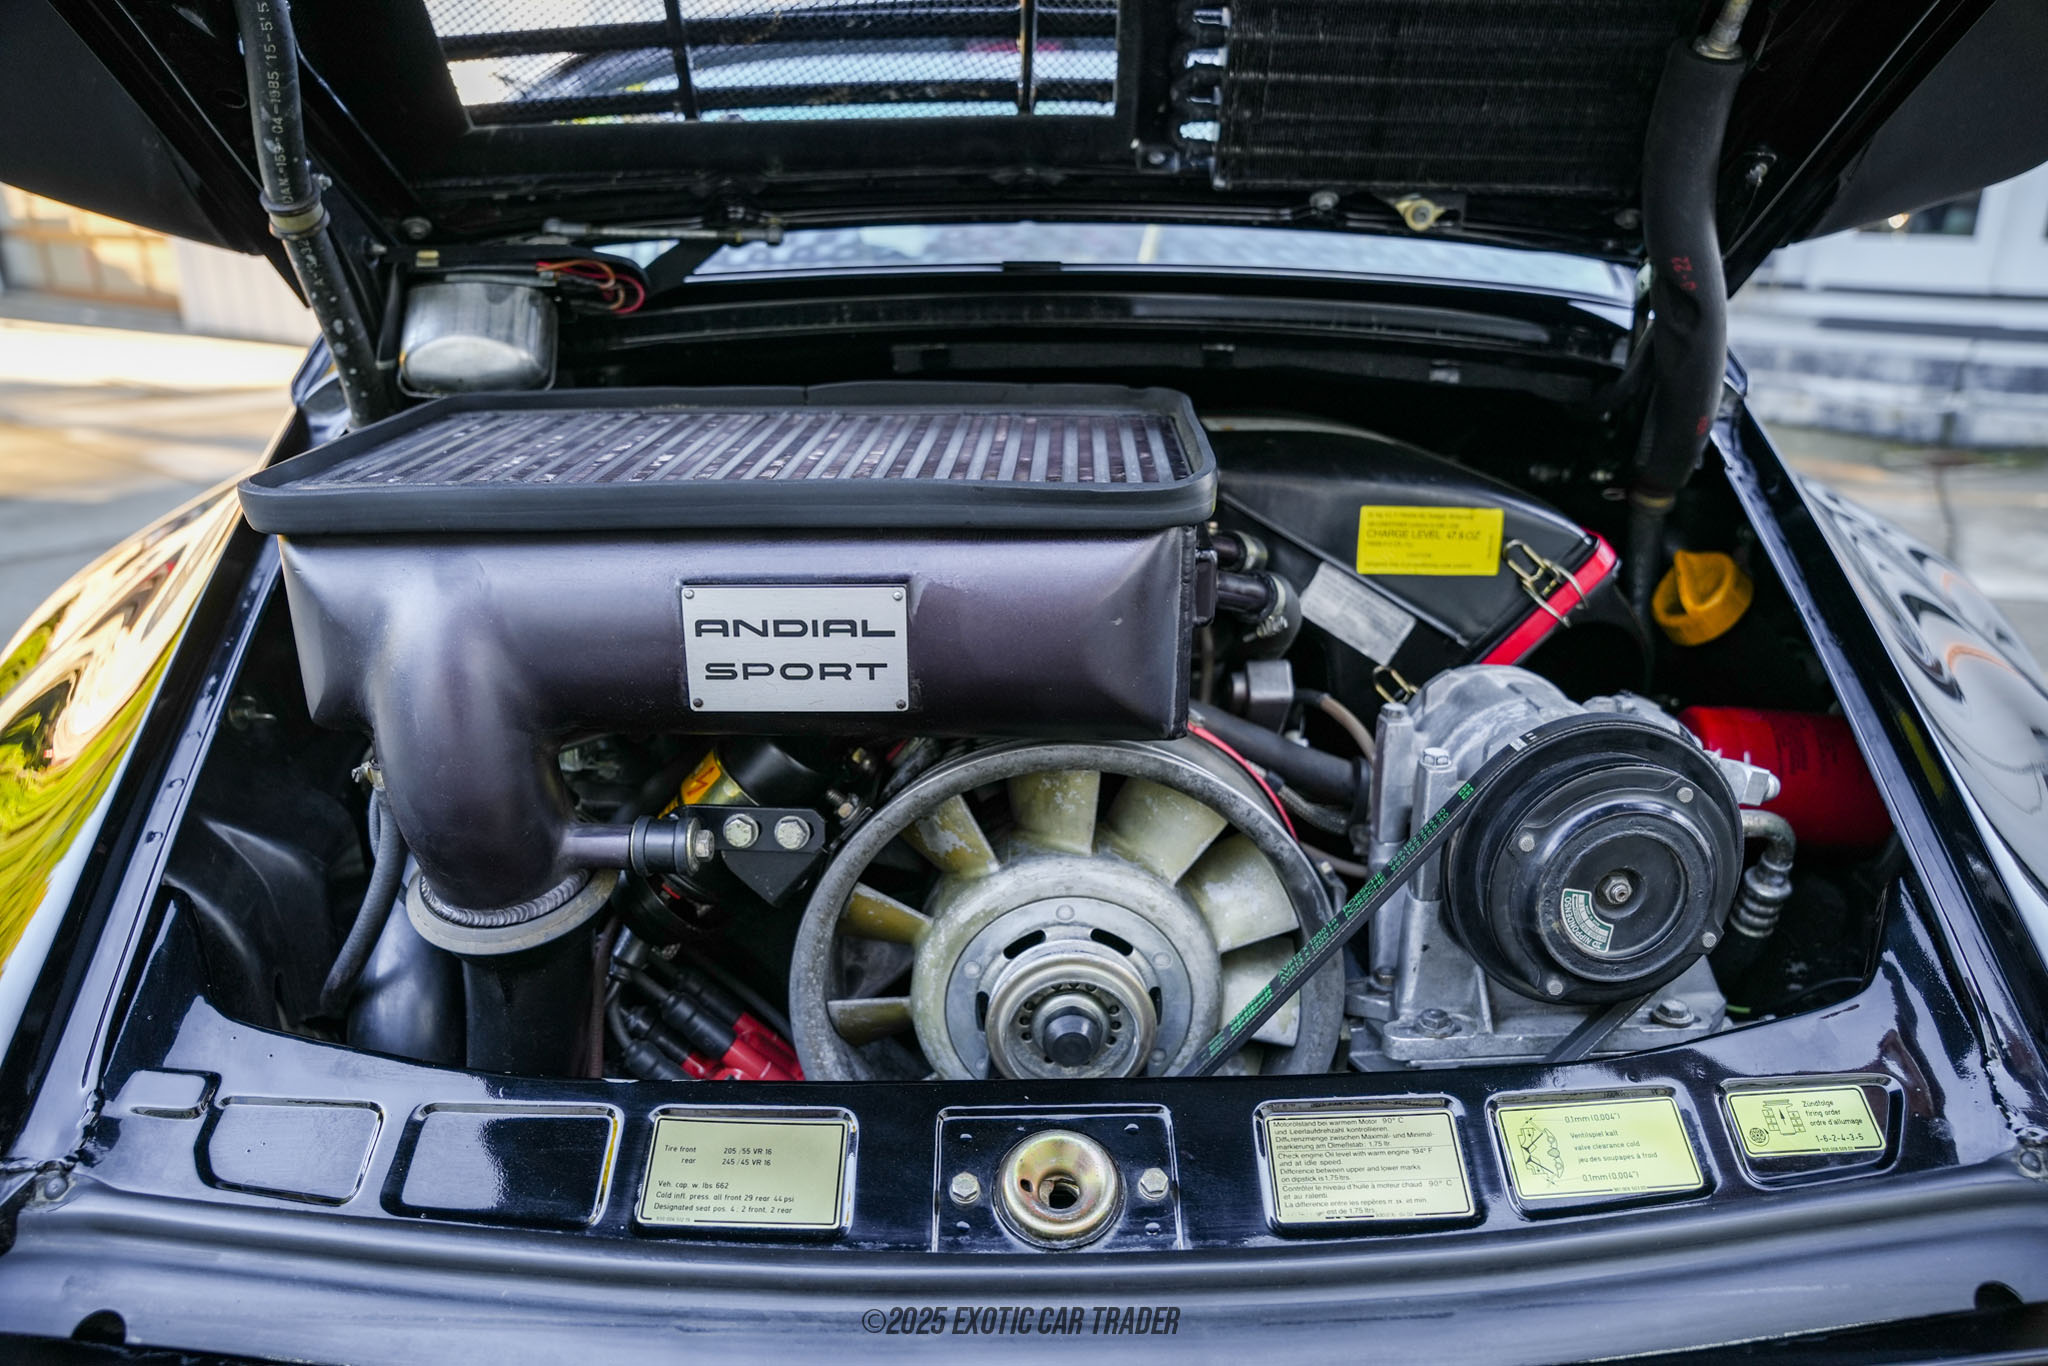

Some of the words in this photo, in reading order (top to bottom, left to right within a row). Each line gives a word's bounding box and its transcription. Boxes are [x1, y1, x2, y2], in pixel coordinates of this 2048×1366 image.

[695, 620, 896, 638] ANDIAL
[705, 663, 888, 680] SPORT
[1342, 871, 1383, 913] PORSCHE
[1344, 875, 1386, 919] PORSCHE
[1564, 896, 1592, 944] NIPPONDENSO
[1816, 1133, 1864, 1142] 1-6-2-4-3-5
[654, 1203, 694, 1211] Designated
